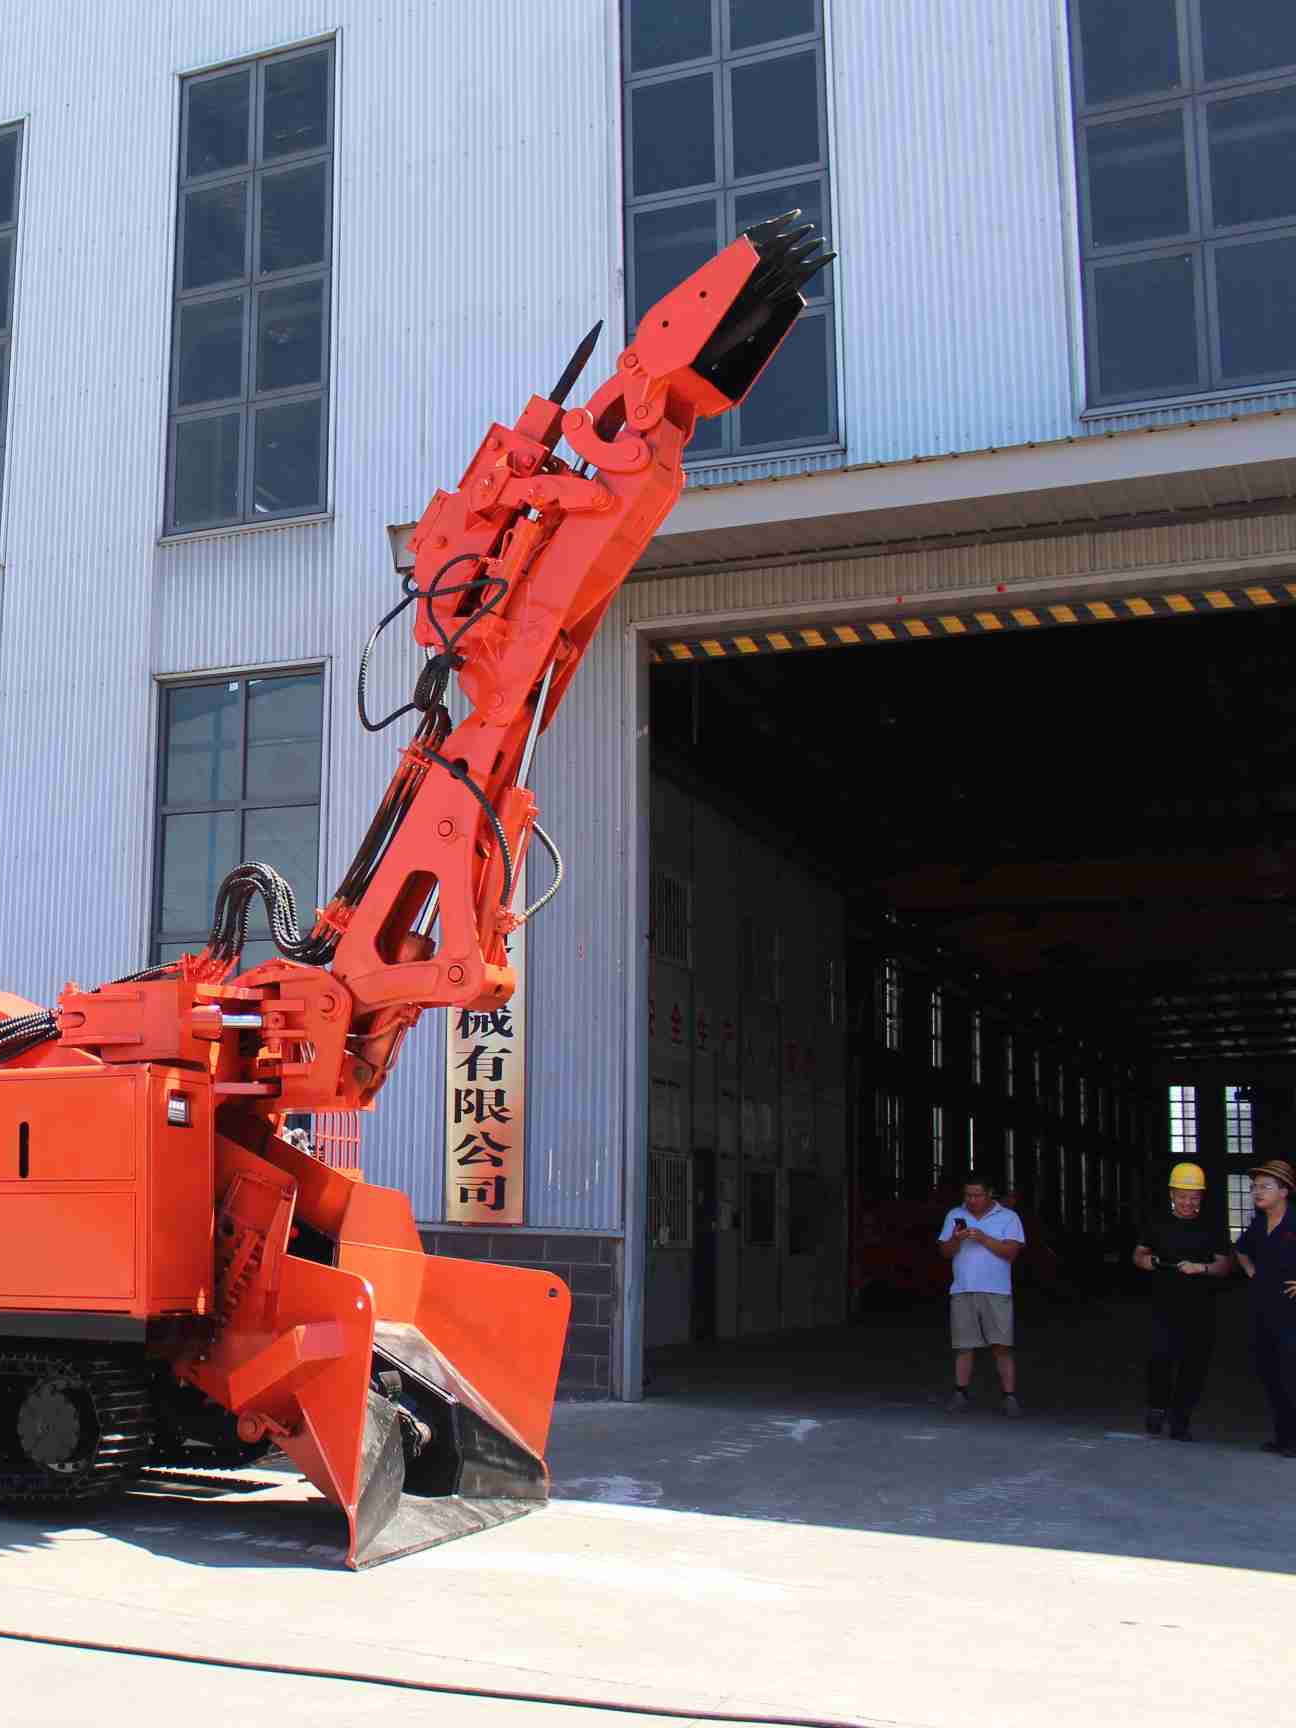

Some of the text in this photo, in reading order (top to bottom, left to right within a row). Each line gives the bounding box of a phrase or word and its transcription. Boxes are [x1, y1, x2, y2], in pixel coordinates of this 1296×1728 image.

[454, 1008, 514, 1211] 械有限公司
